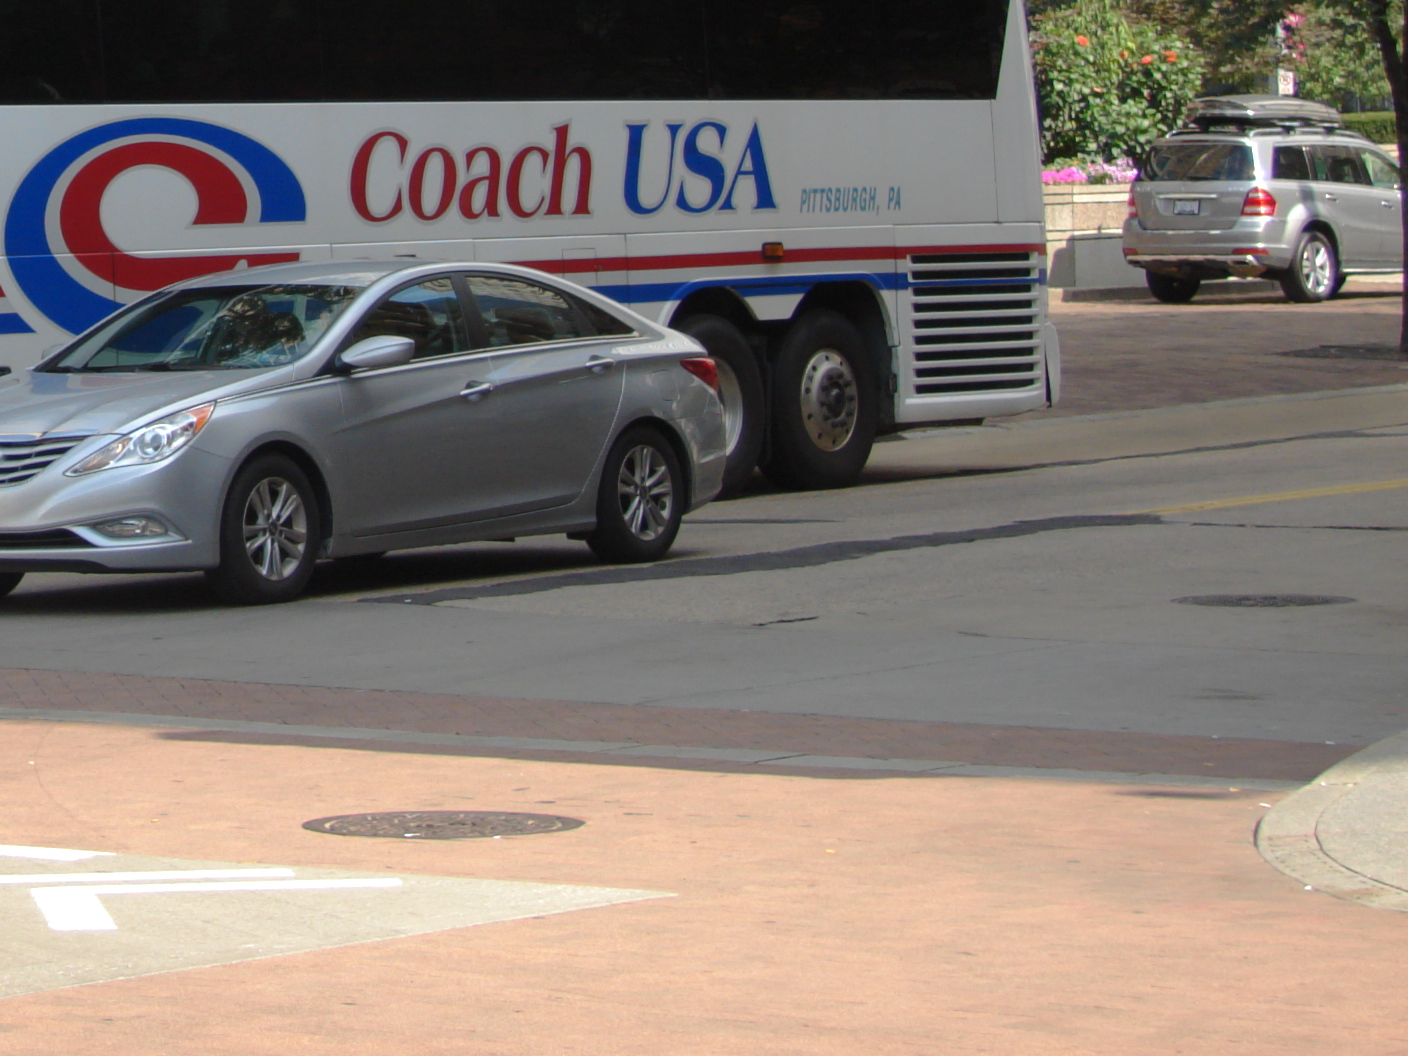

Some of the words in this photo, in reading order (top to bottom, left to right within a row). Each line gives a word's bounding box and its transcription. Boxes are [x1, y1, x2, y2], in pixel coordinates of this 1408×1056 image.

[349, 123, 592, 222] Coach
[622, 121, 778, 214] USA
[799, 186, 880, 216] PITTSBURGH,
[888, 186, 901, 211] PA
